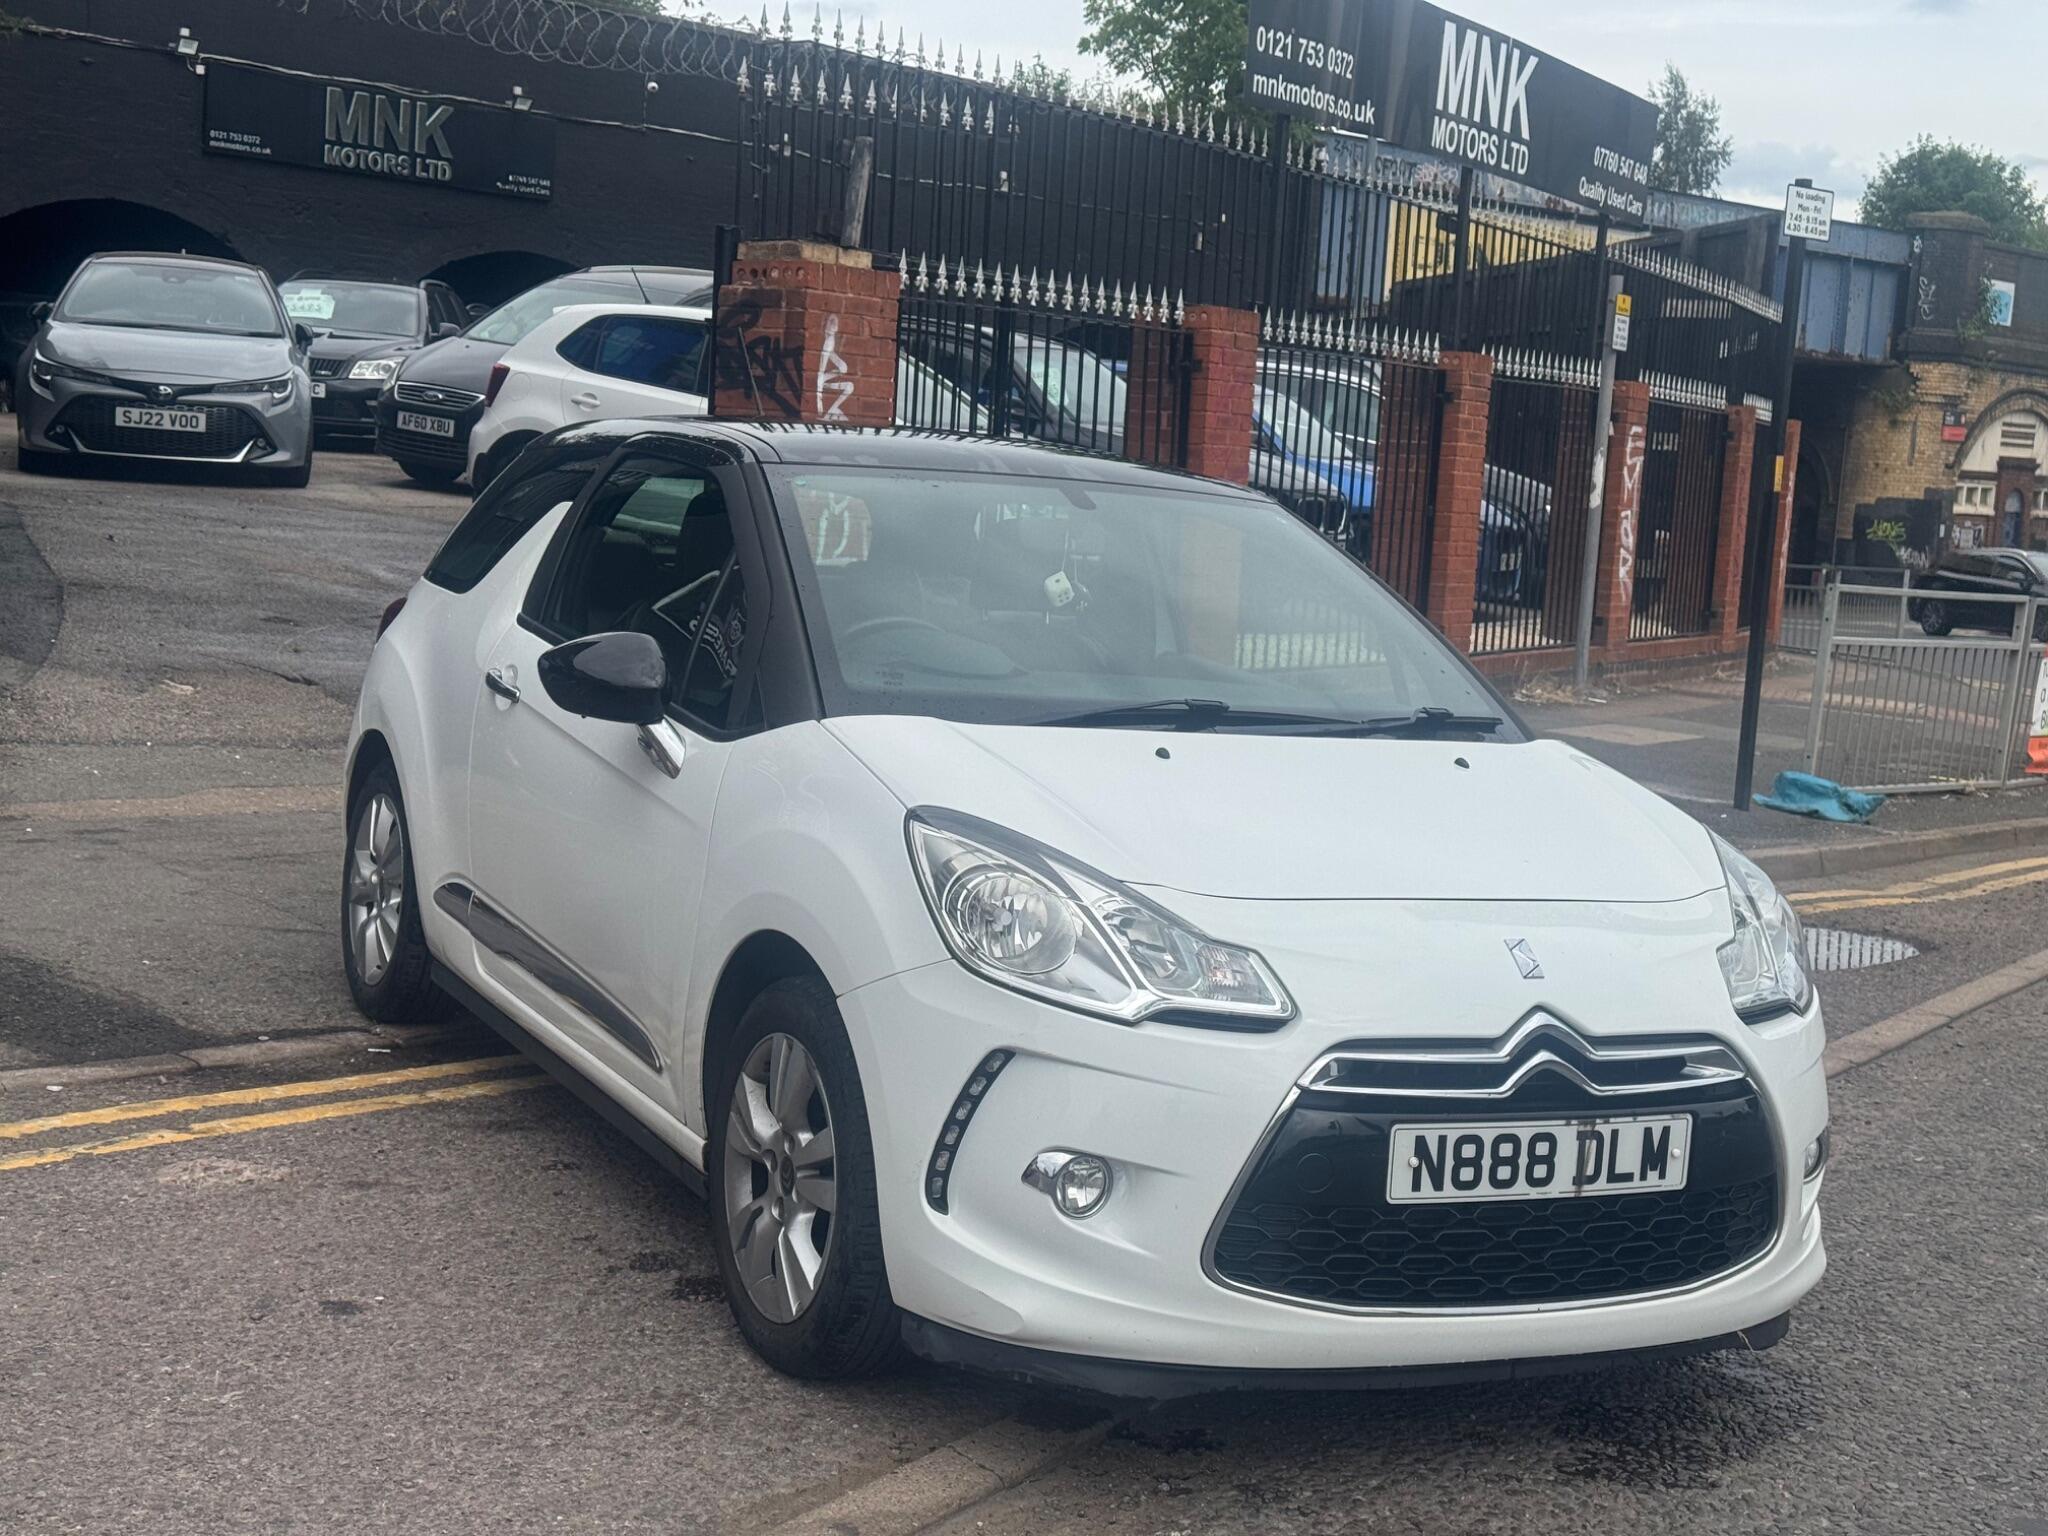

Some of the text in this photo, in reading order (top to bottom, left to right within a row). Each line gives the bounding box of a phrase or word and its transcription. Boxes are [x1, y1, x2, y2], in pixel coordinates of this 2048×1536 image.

[1256, 25, 1354, 79] 0121 753 0372
[1253, 73, 1375, 125] mnkmotors.co.uk
[1436, 20, 1539, 141] MNK
[209, 129, 227, 139] 0121
[325, 86, 454, 159] MNK
[324, 144, 453, 181] MOTORS LTD
[1431, 115, 1499, 166] MOTORS
[1501, 138, 1529, 176] LTD
[1594, 145, 1648, 185] 07760 547 648
[1579, 176, 1607, 208] Quality
[1607, 186, 1627, 210] Used
[1627, 194, 1643, 216] Cars
[1796, 190, 1826, 205] No loading
[122, 410, 164, 427] SJ22
[401, 413, 450, 434] AF60 XBU
[1410, 1125, 1672, 1193] N888 DLM
